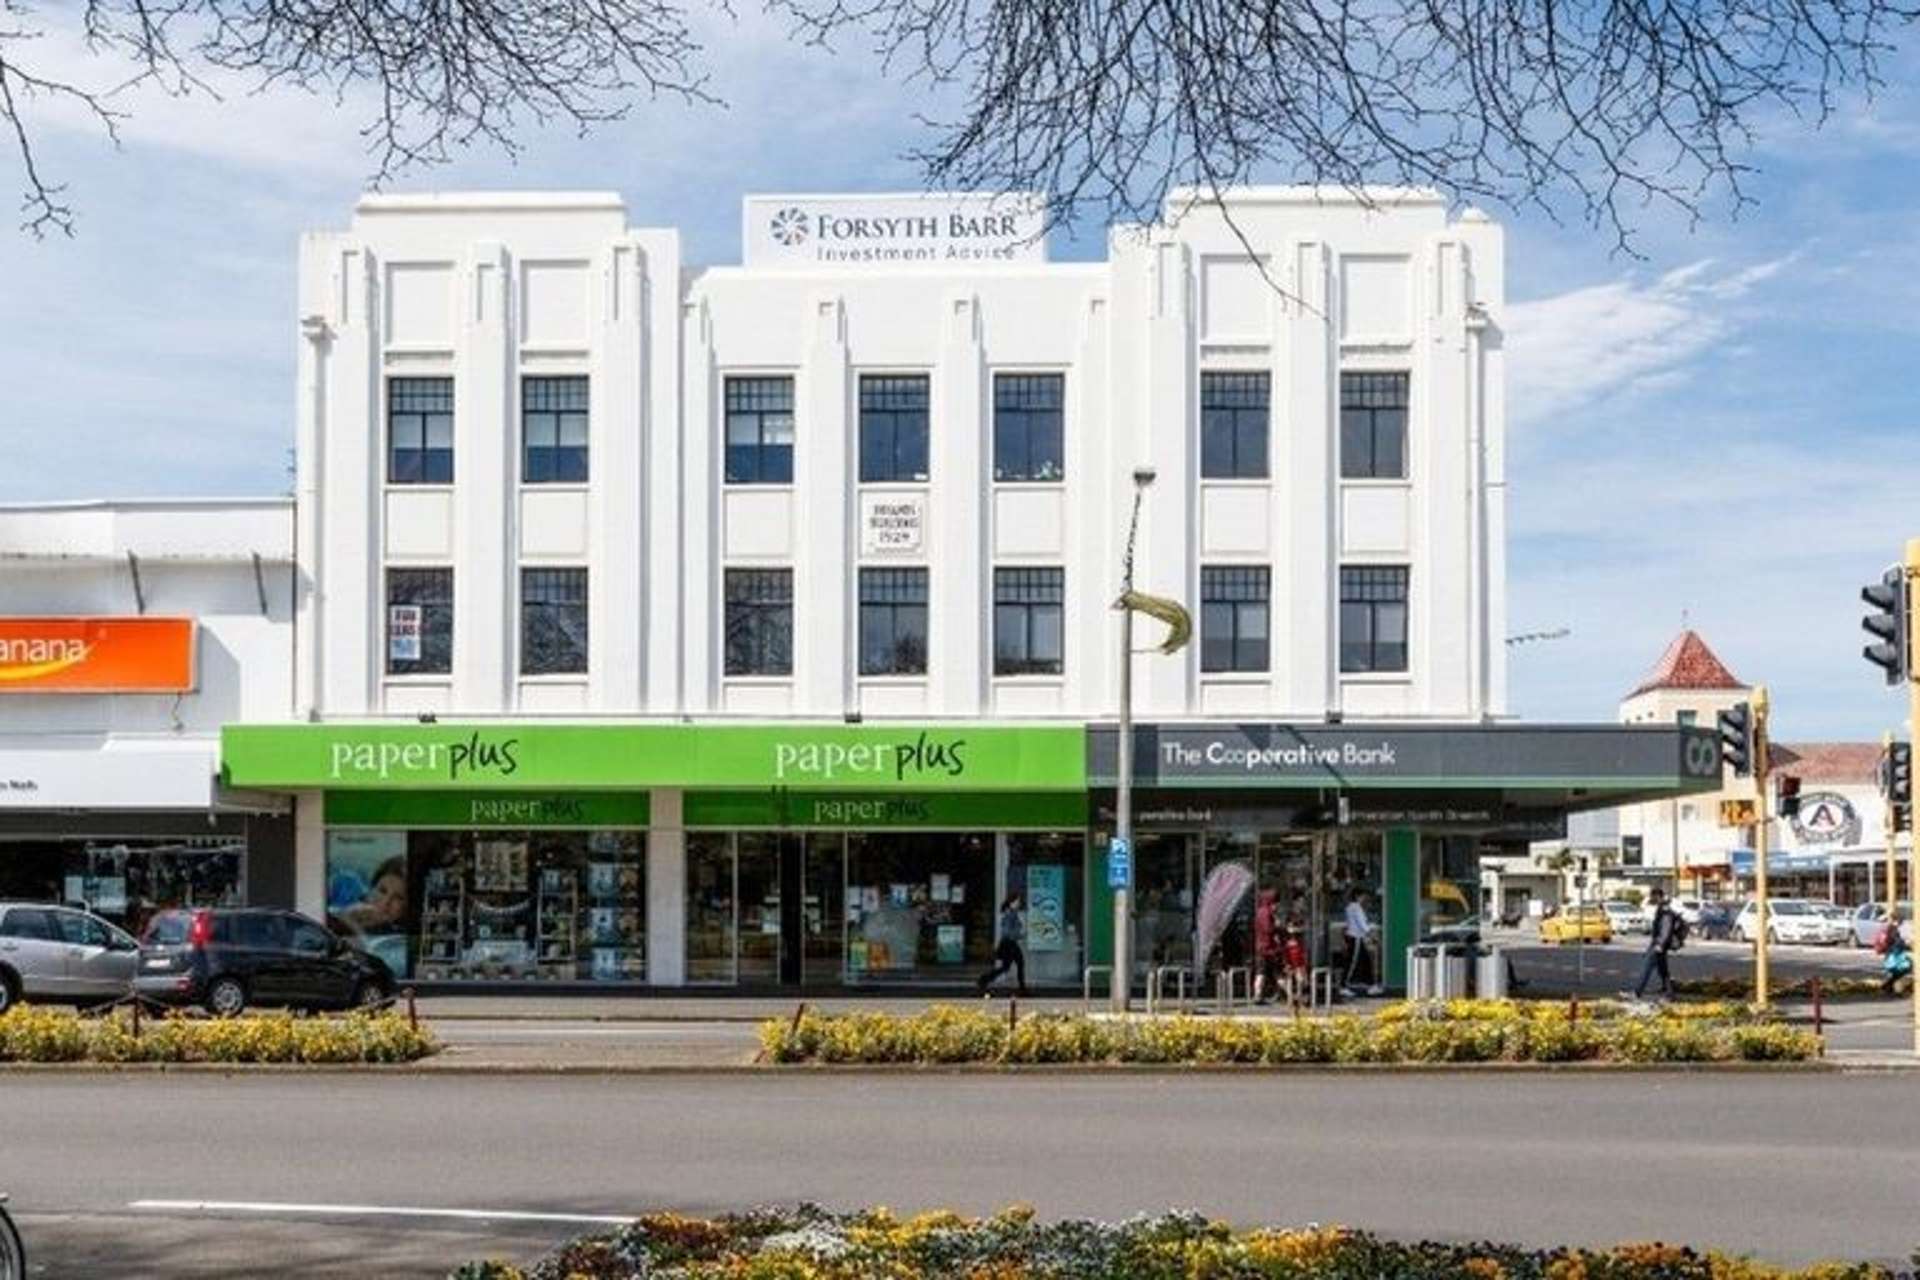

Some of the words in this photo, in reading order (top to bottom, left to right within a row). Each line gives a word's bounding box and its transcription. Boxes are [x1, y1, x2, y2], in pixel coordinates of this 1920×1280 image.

[817, 214, 938, 239] FORSYTH
[949, 213, 1017, 238] BARR
[817, 246, 936, 261] Investment
[946, 244, 1016, 261] Advice
[330, 740, 446, 778] paper
[449, 731, 518, 779] plus
[775, 740, 890, 778] paper
[896, 732, 965, 779] plus
[1163, 743, 1201, 763] The
[1207, 742, 1340, 768] Cooperative
[1343, 743, 1396, 763] Bank
[470, 799, 540, 822] paper
[813, 799, 886, 823] paper
